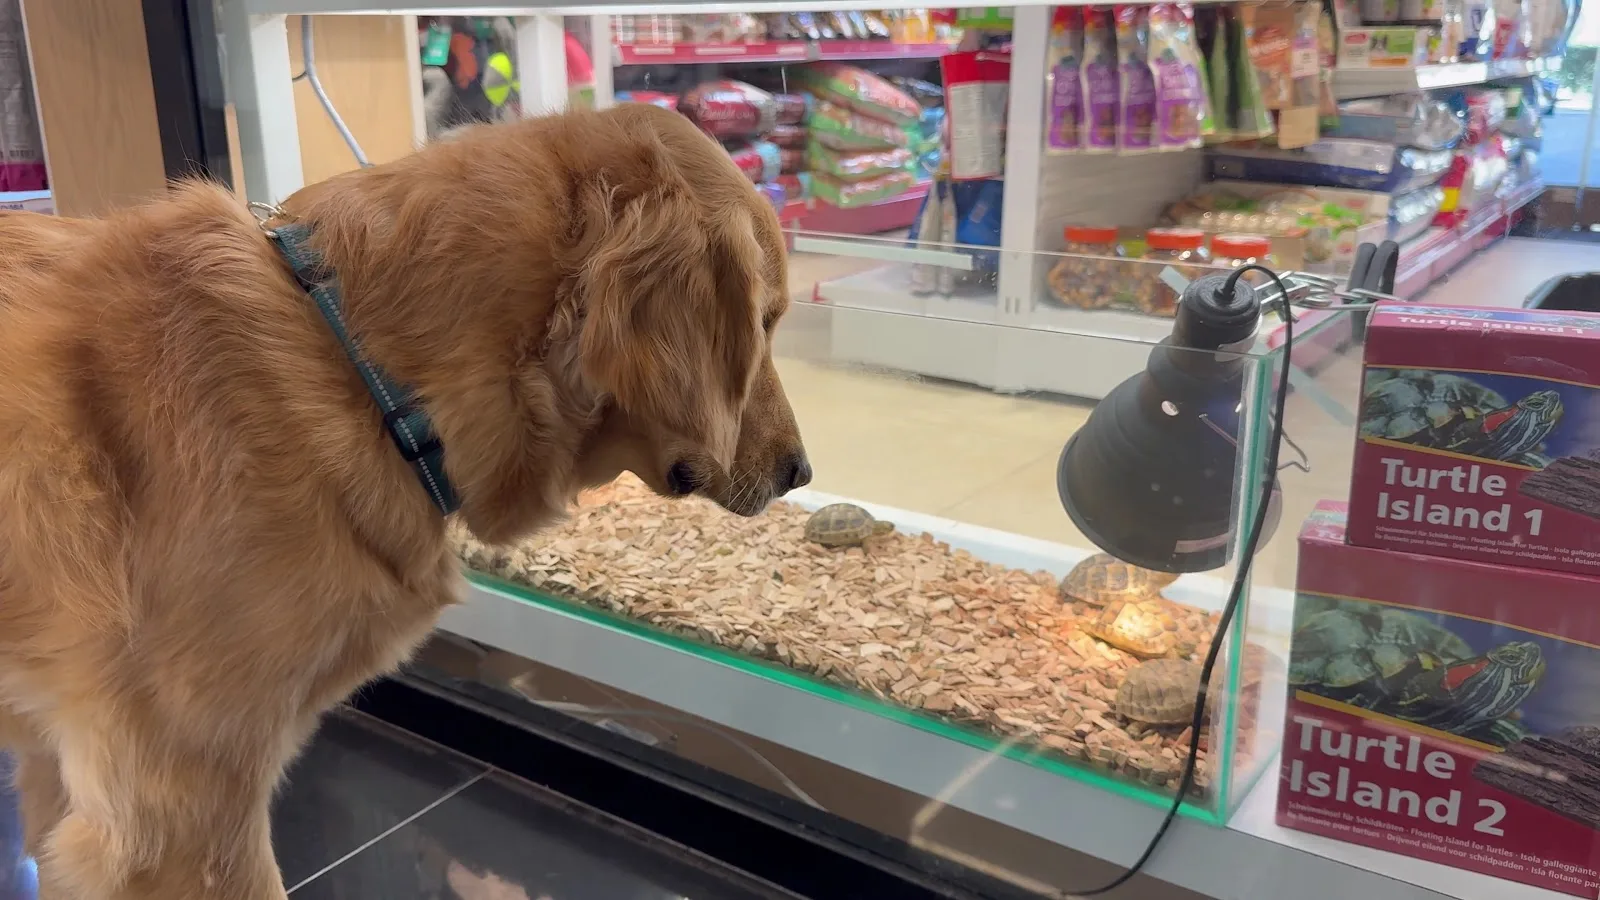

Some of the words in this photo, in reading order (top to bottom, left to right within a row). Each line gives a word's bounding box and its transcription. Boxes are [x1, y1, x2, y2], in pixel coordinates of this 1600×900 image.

[1397, 316, 1472, 327] Turtle
[1483, 321, 1564, 334] Island
[1380, 457, 1507, 496] Turtle
[1376, 492, 1511, 532] Island
[1524, 509, 1543, 536] 1
[1528, 543, 1548, 552] Turtles
[1293, 715, 1456, 779] Turtle
[1289, 759, 1462, 826] Island
[1473, 798, 1507, 837] 2
[1386, 833, 1420, 847] Drijvend
[1422, 842, 1447, 853] eiland
[1448, 848, 1467, 858] voor
[1469, 852, 1524, 871] schildpadden
[1530, 866, 1546, 876] Isla
[1548, 870, 1582, 884] flotante
[1410, 827, 1444, 843] Floating
[1445, 835, 1470, 848] Island
[1472, 840, 1484, 852] for
[1486, 844, 1514, 858] Turtles
[1520, 852, 1540, 864] Isola
[1542, 859, 1598, 877] galleggiante
